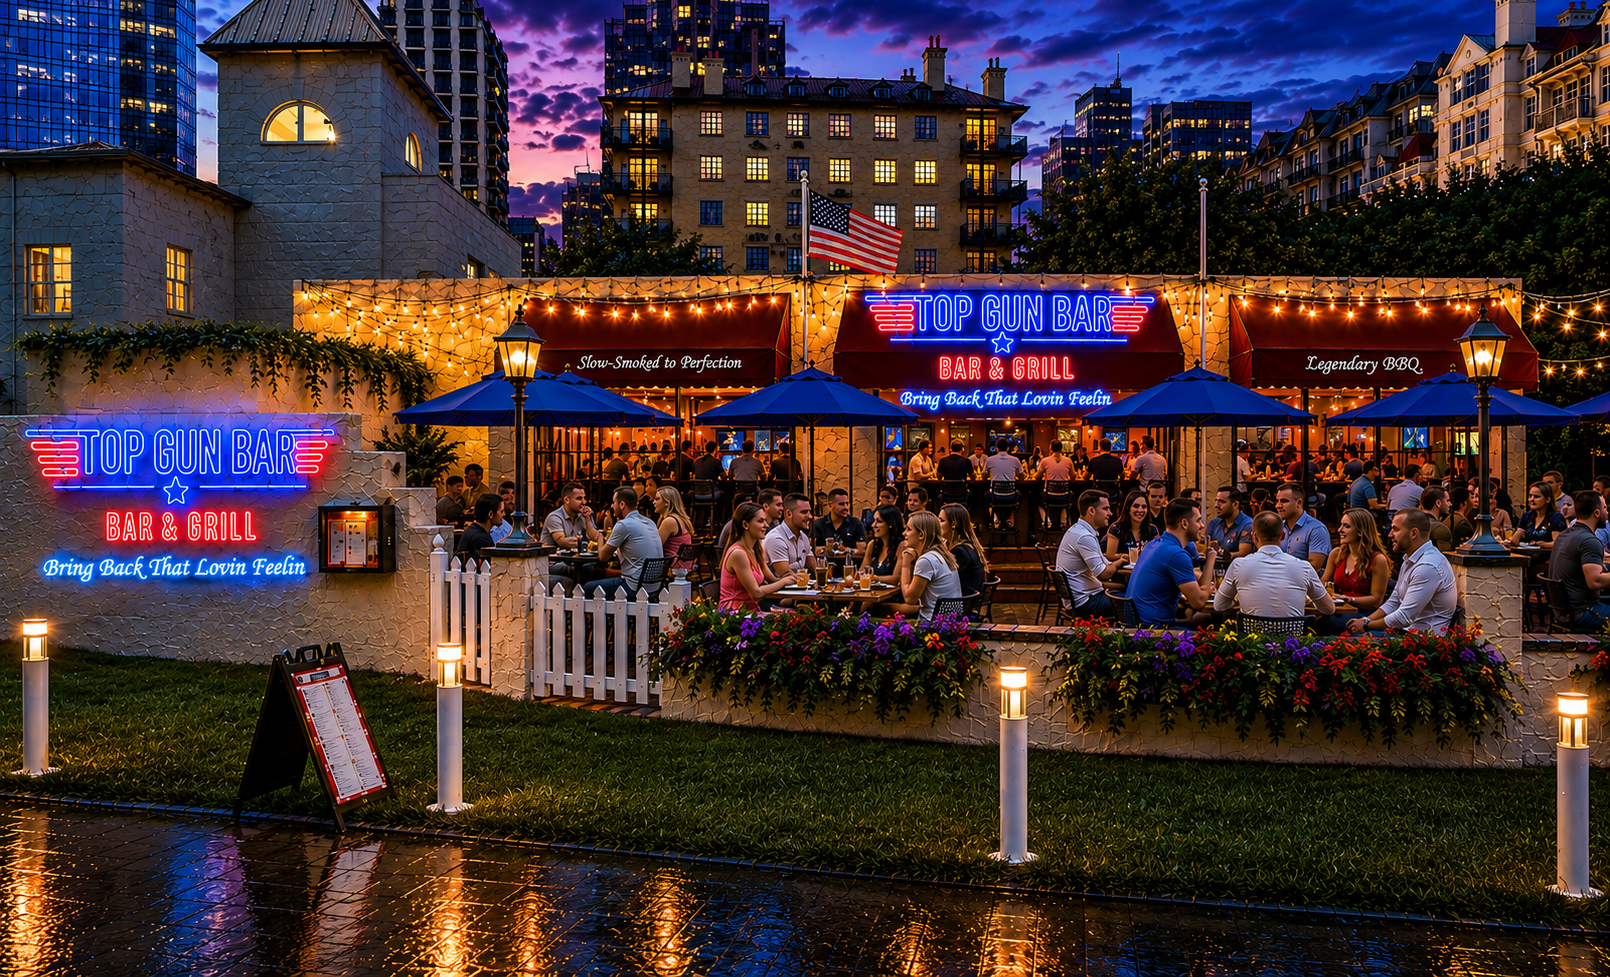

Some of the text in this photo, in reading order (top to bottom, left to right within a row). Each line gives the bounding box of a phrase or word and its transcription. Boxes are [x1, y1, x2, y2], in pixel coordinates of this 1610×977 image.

[914, 294, 1112, 332] TOP GUN BAR
[577, 354, 742, 373] Slow-Smoked to Perfection
[939, 356, 1075, 380] BAR & GRILL
[1305, 355, 1378, 375] Legendary
[900, 389, 1113, 410] Bring Back That Lovin Feelin
[80, 428, 296, 475] TOP GUN BAR
[105, 511, 257, 542] BAR & GRILL
[43, 555, 306, 582] Bring Back That Lovin Feelin
